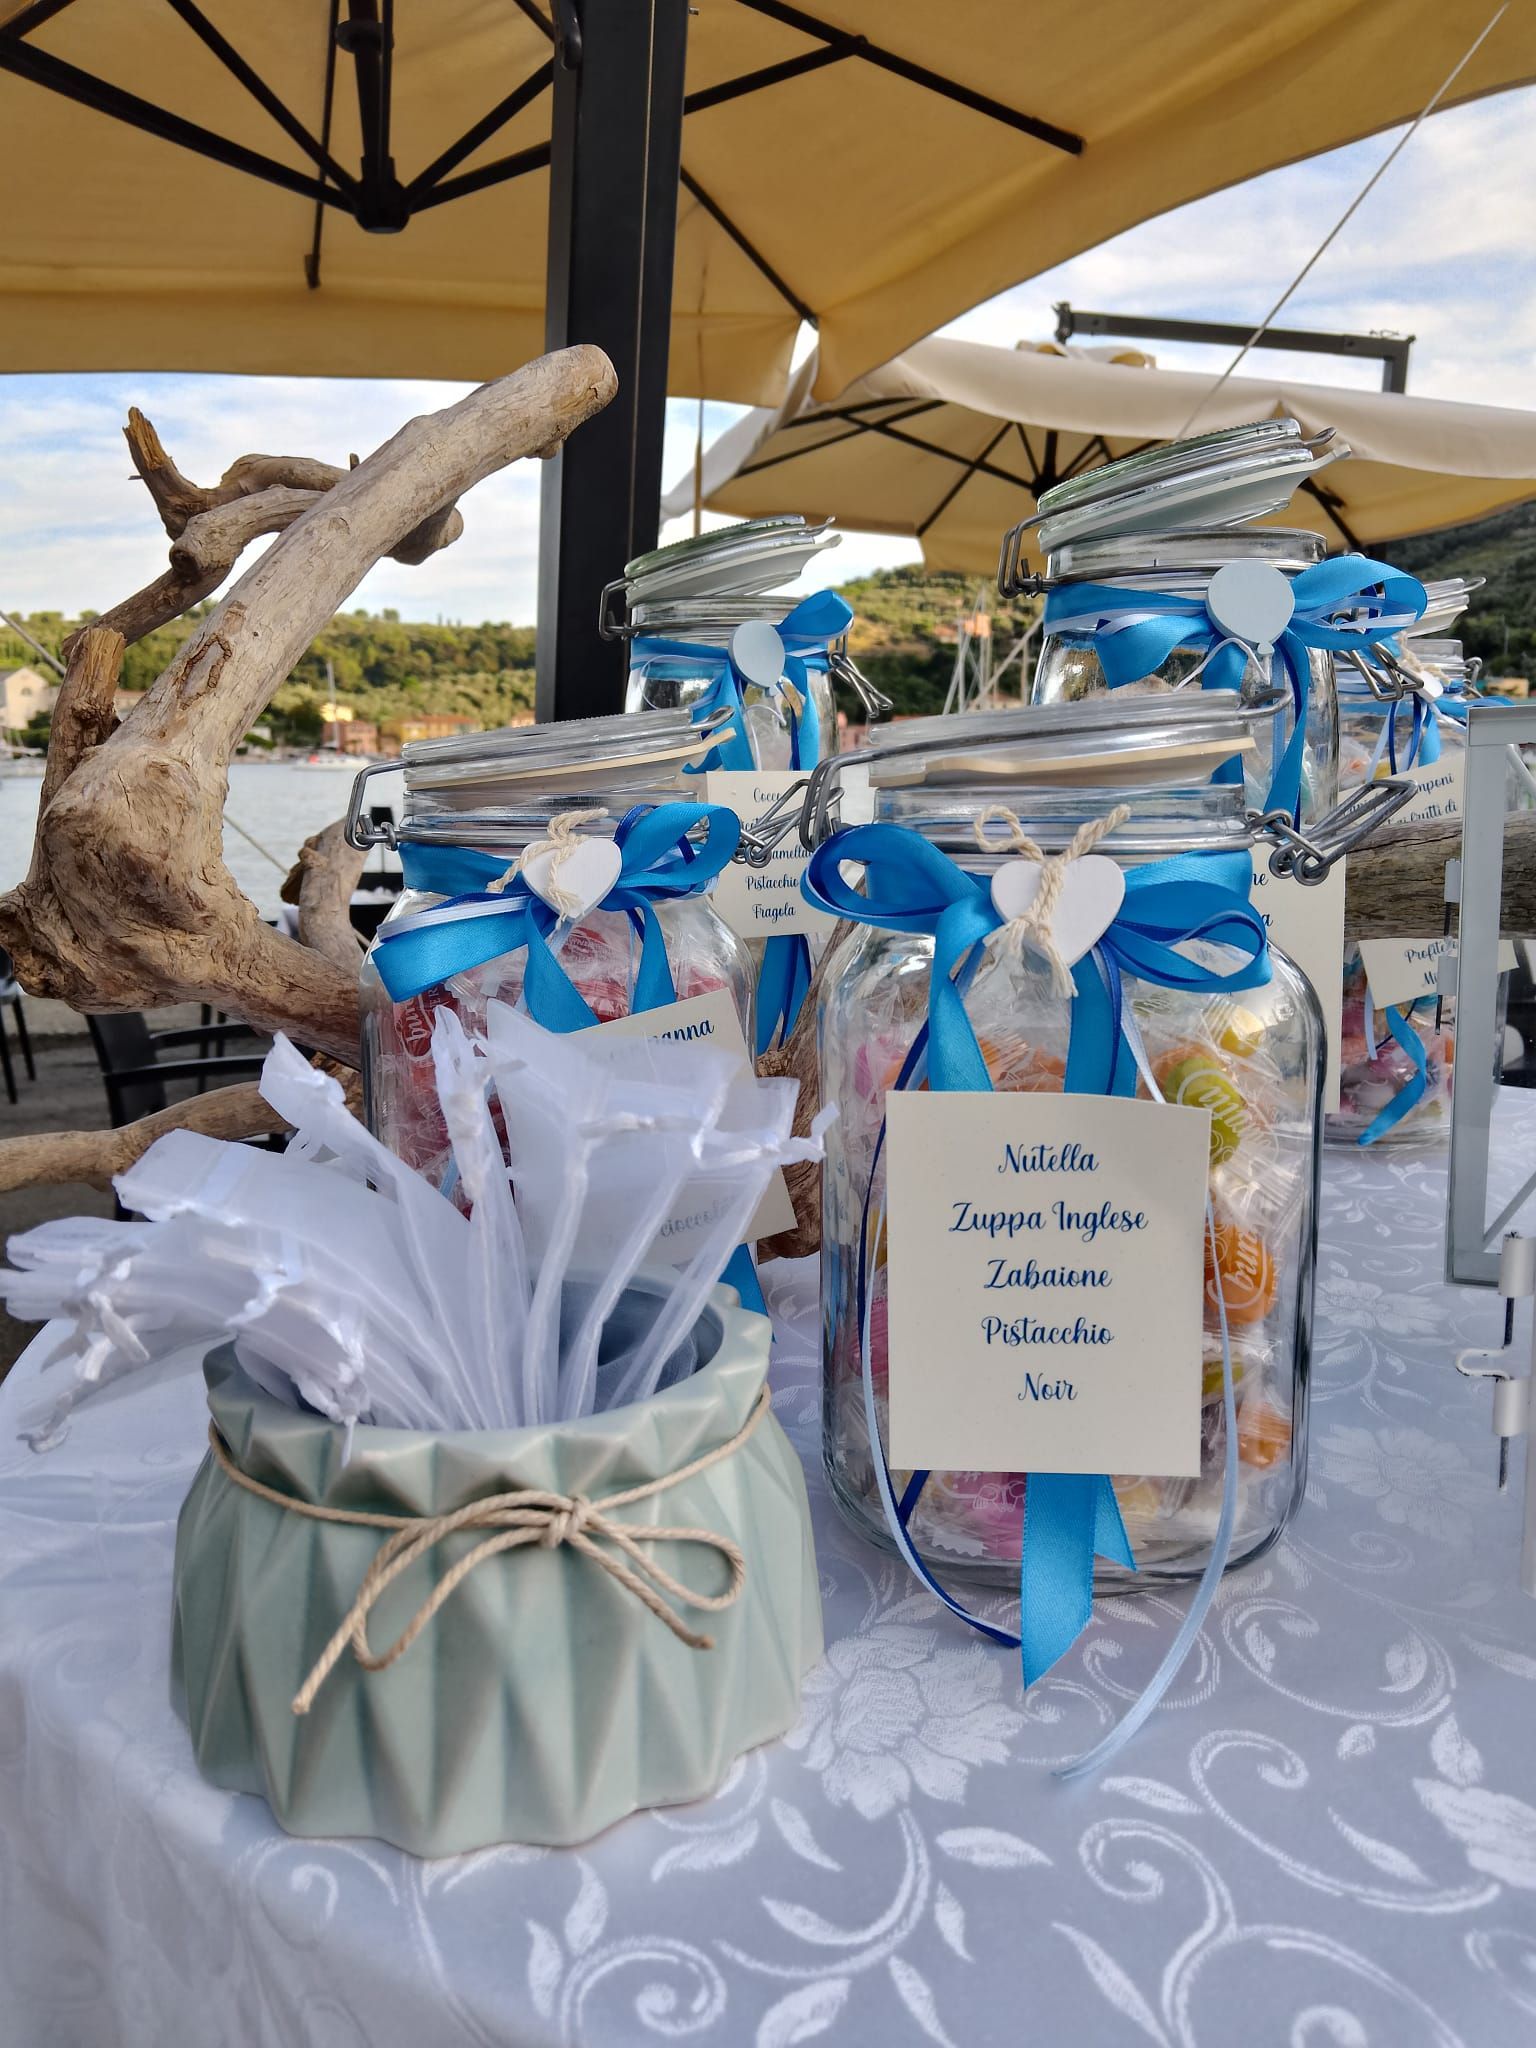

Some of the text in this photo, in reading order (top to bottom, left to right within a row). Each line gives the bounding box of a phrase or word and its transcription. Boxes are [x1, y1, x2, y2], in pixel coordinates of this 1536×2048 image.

[745, 873, 800, 891] Pistacchio
[752, 902, 797, 924] Fragola
[997, 1143, 1100, 1174] Nutella
[948, 1200, 1150, 1243] Zuppa Inglese
[983, 1258, 1113, 1290] Zabaione
[980, 1315, 1115, 1348] Pistacchio
[1017, 1372, 1079, 1402] Noir
